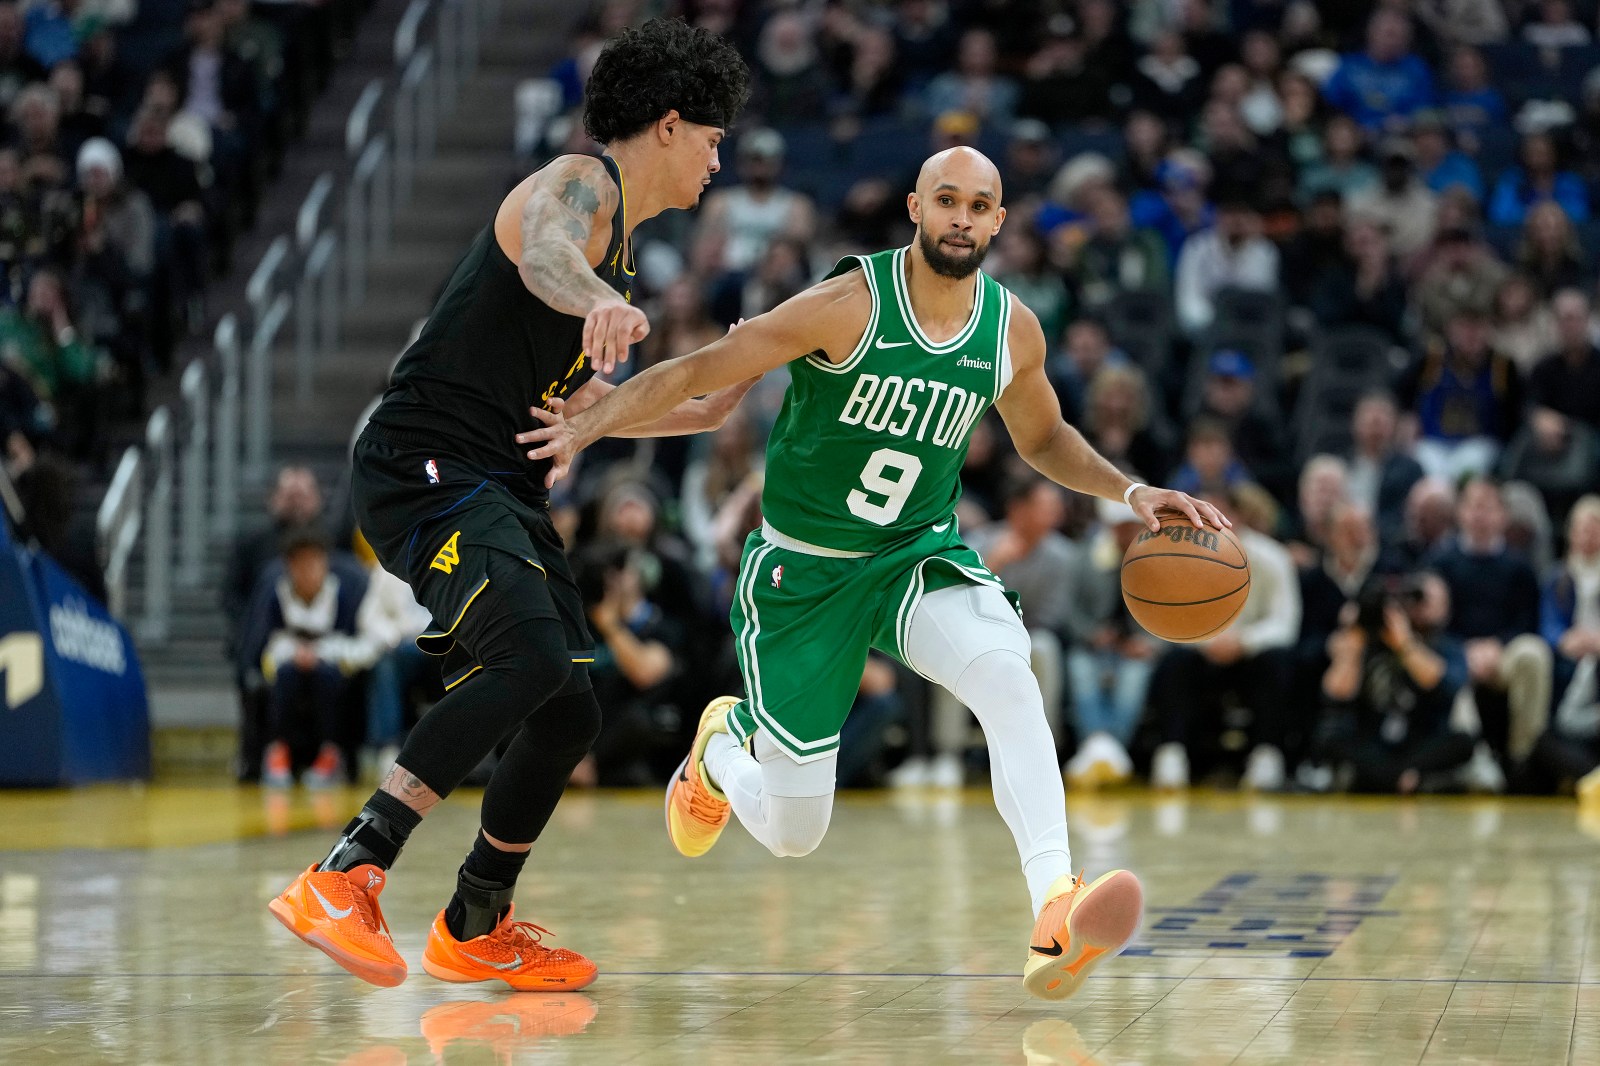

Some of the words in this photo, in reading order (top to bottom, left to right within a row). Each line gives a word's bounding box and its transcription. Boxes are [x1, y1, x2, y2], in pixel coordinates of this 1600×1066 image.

[956, 354, 992, 371] Amica
[838, 373, 986, 450] BOSTON
[846, 448, 923, 526] 9
